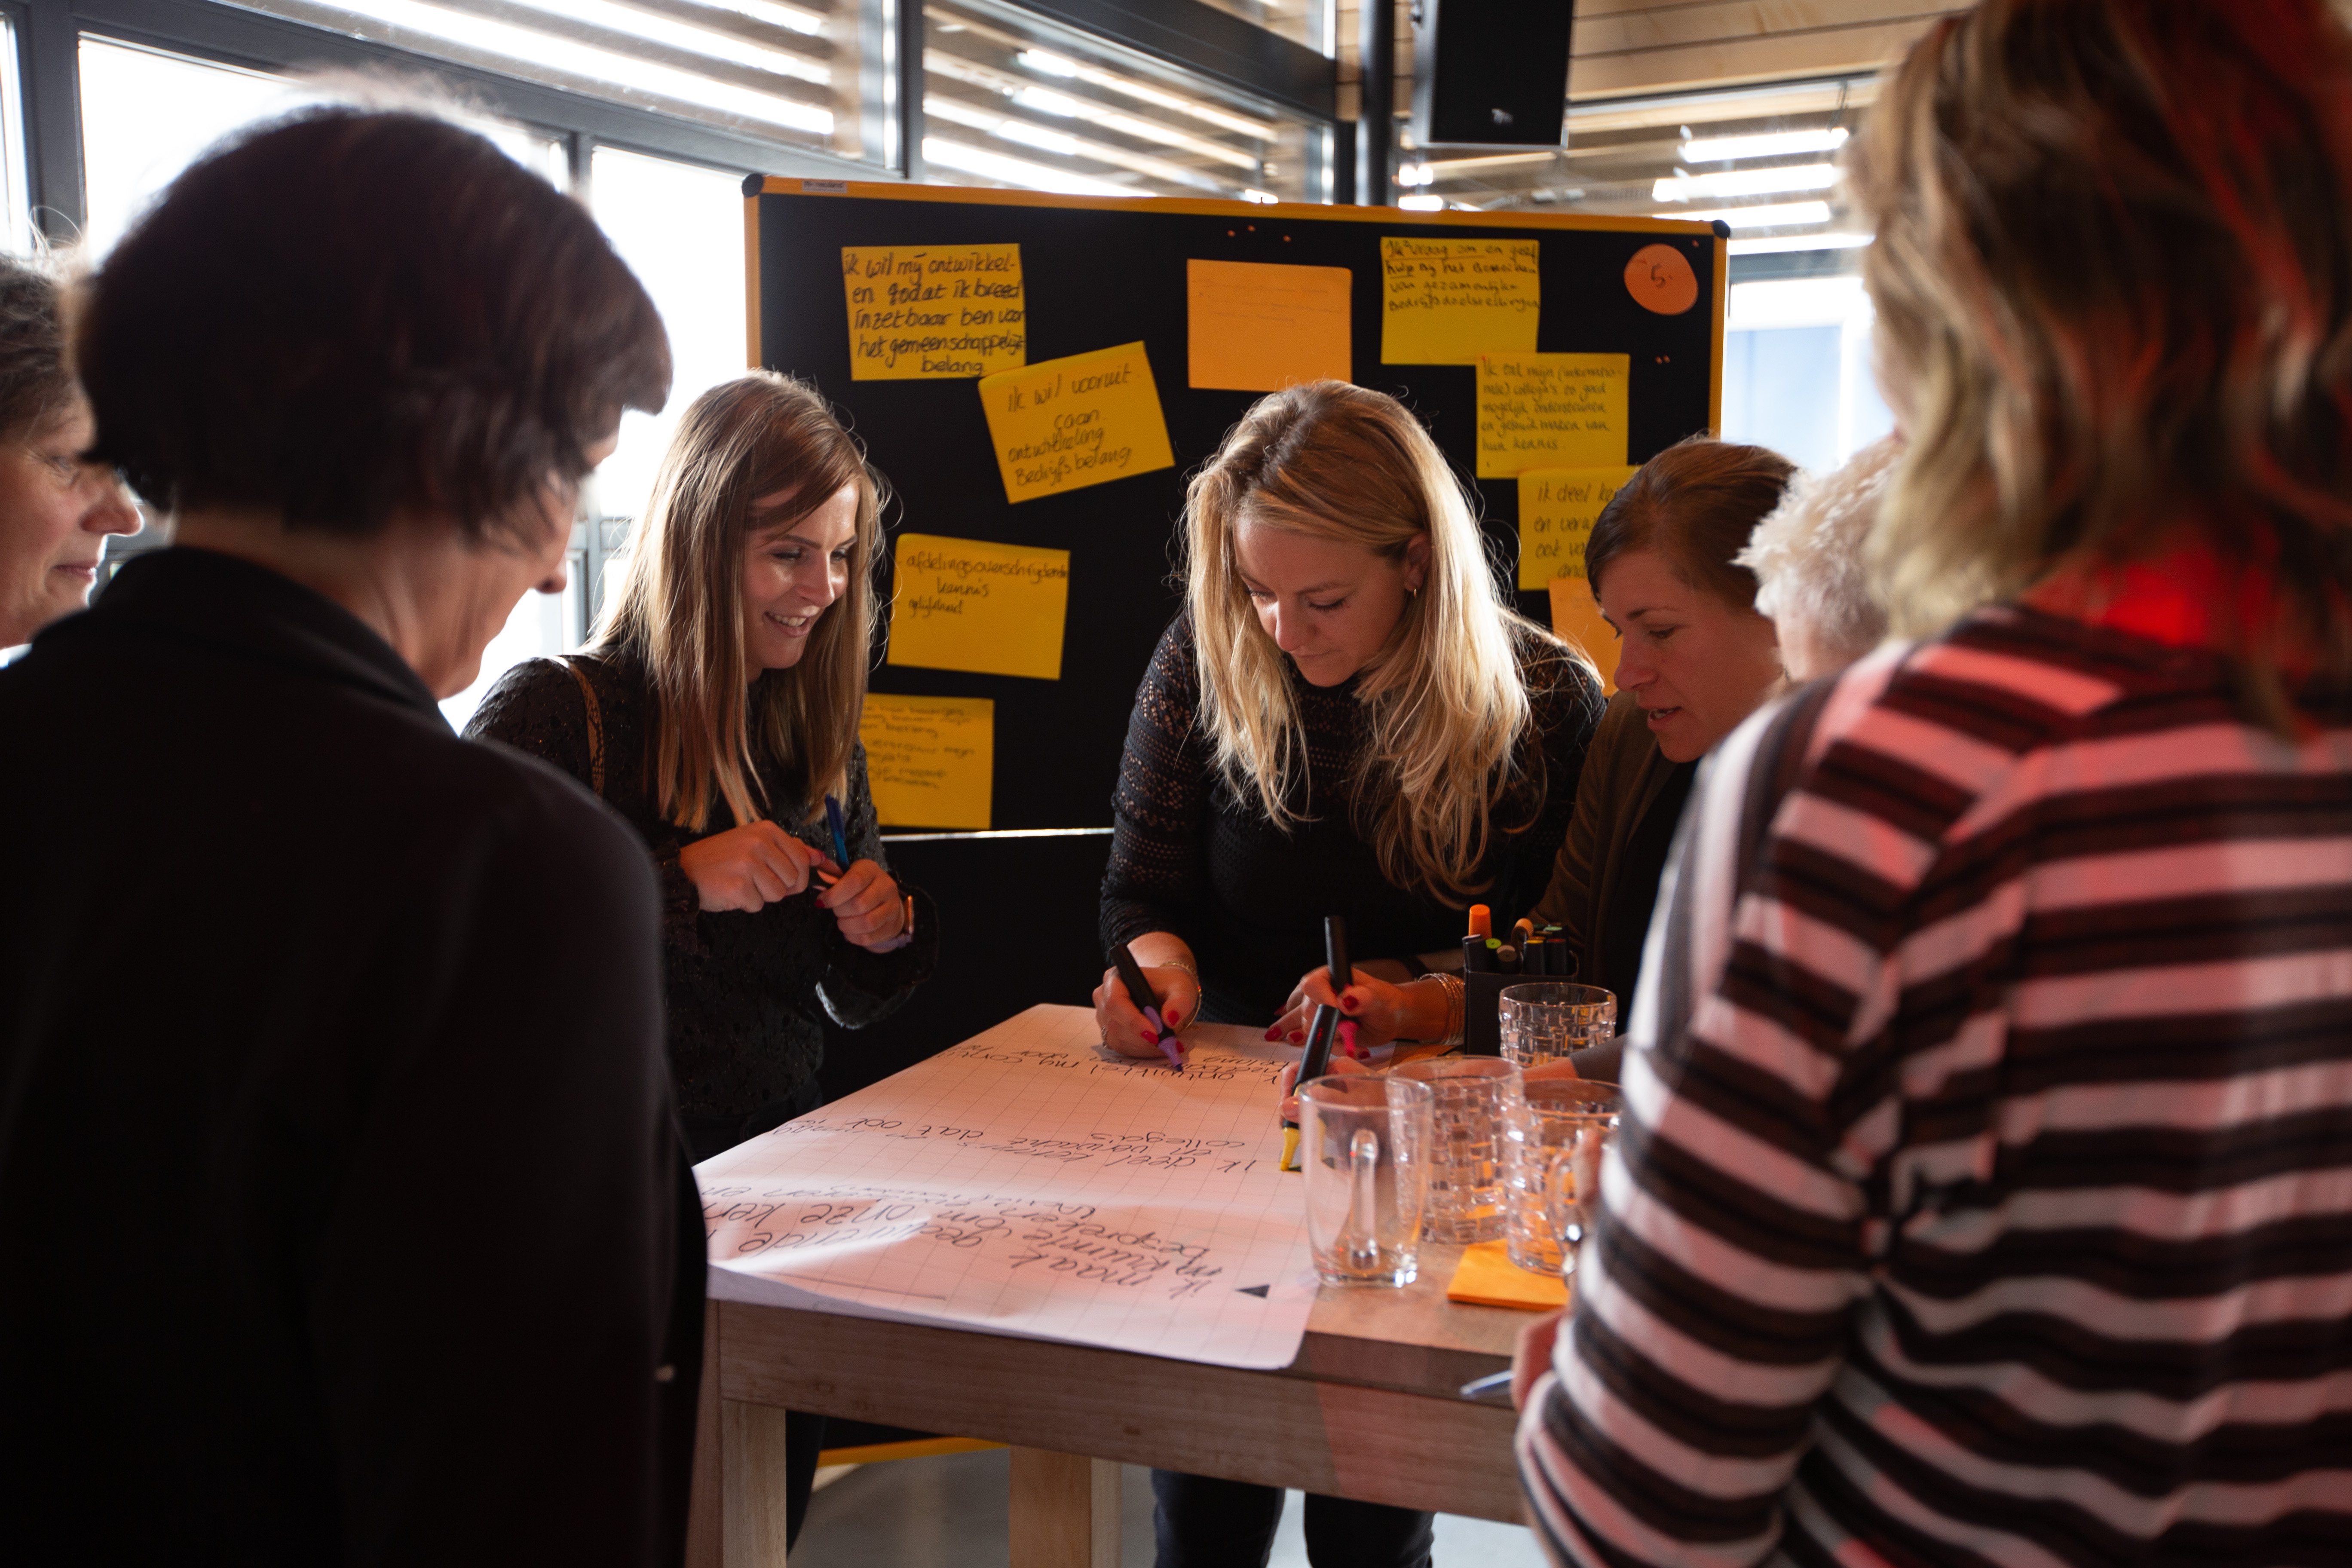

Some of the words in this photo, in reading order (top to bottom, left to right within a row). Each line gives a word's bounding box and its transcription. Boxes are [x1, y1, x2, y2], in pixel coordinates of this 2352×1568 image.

[844, 253, 861, 275] ik
[865, 251, 894, 279] wil
[852, 287, 875, 304] en
[952, 279, 972, 298] ik
[974, 277, 1021, 299] breed
[854, 306, 953, 330] inzetbaar
[960, 306, 994, 327] ben
[998, 306, 1025, 324] voor
[858, 334, 888, 358] het
[921, 355, 984, 376] belang
[1034, 373, 1063, 405] wil
[1072, 362, 1132, 394] vooruit
[1556, 482, 1592, 504] deel
[1534, 516, 1551, 533] en
[937, 576, 989, 598] kennis
[845, 1118, 903, 1130] ook
[916, 1125, 984, 1140] dat
[1007, 1138, 1149, 1154] verwacht
[1090, 1131, 1245, 1148] collega's
[1104, 1155, 1197, 1170] deel
[1170, 1148, 1212, 1156] en
[800, 1203, 916, 1225] onze
[937, 1210, 1005, 1229] om
[1009, 1248, 1153, 1287] maak
